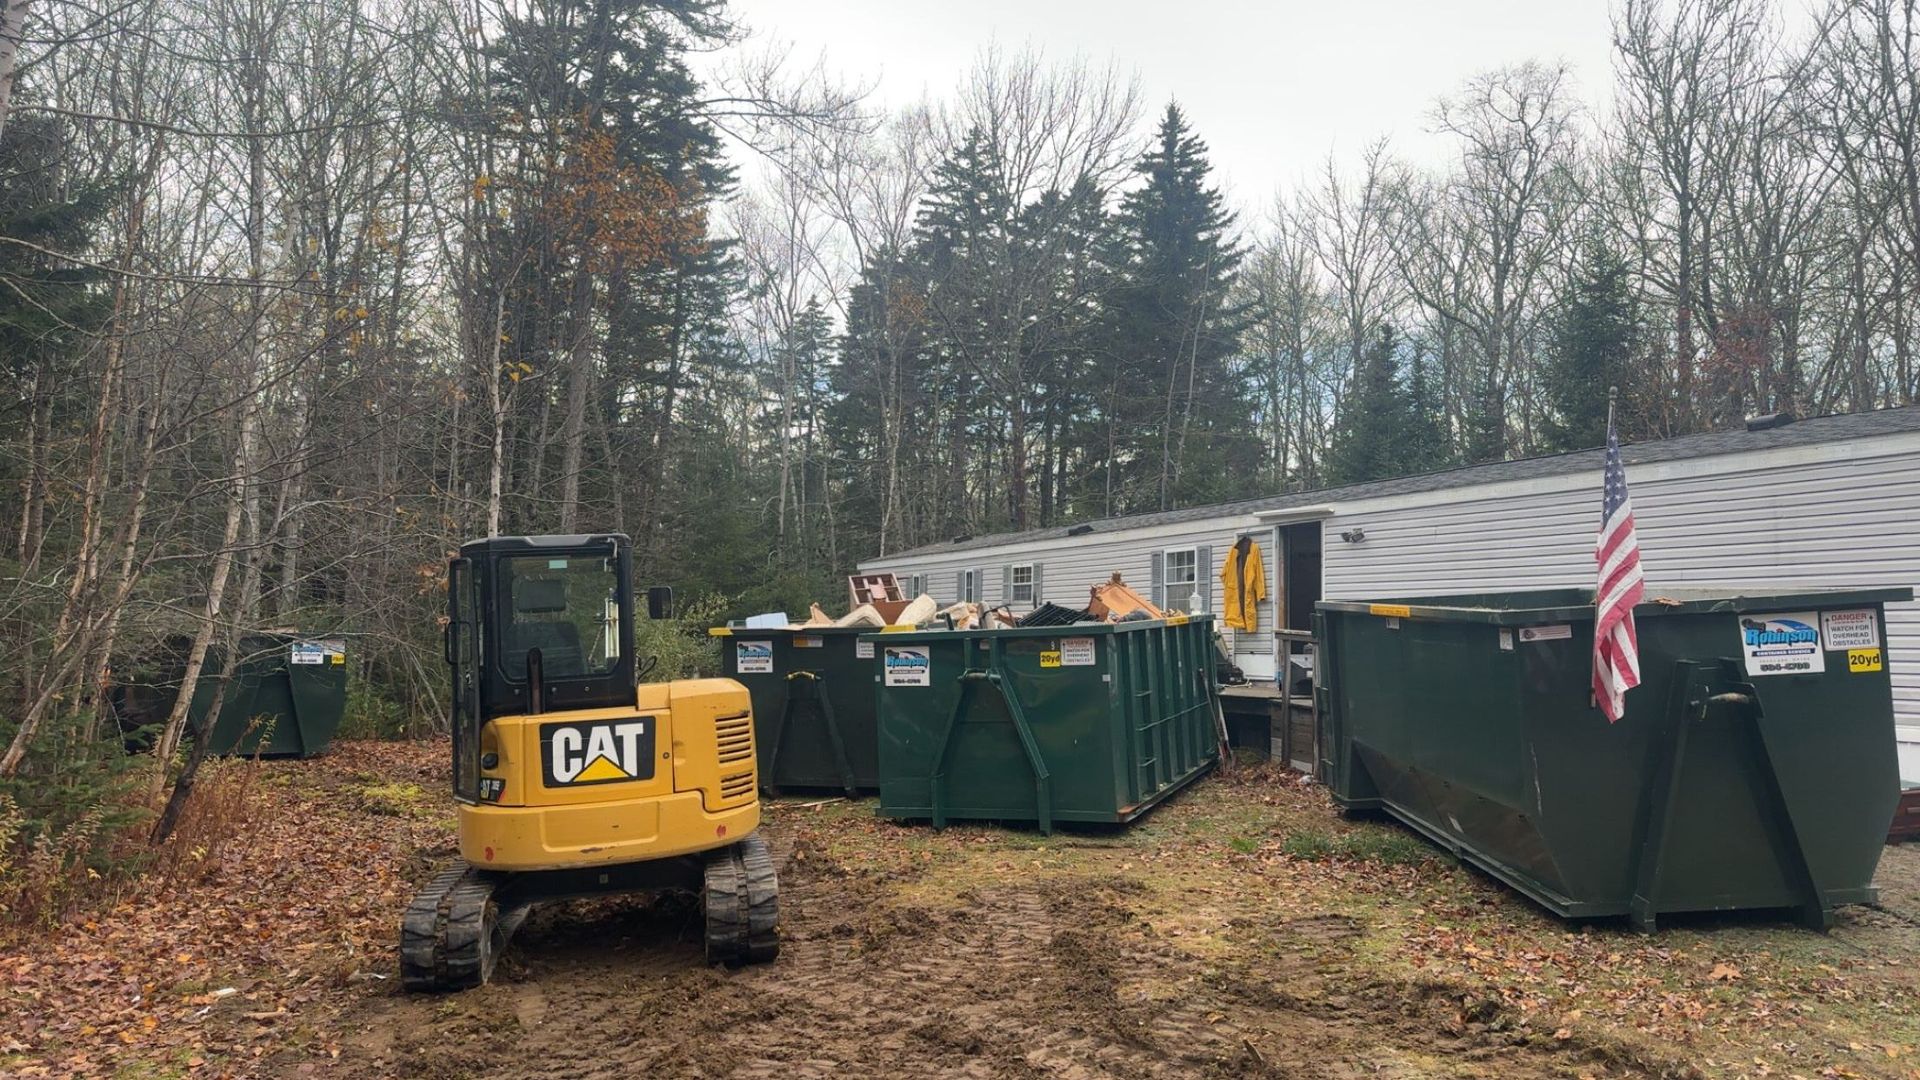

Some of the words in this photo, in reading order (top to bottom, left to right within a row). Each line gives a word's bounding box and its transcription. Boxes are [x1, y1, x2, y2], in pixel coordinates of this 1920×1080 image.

[1831, 613, 1867, 622] DANGER
[1746, 628, 1818, 648] Robinson
[1833, 639, 1871, 647] OBSTACLES
[1041, 654, 1060, 664] 20yd
[1850, 653, 1880, 667] 20yd
[552, 723, 644, 783] CAT
